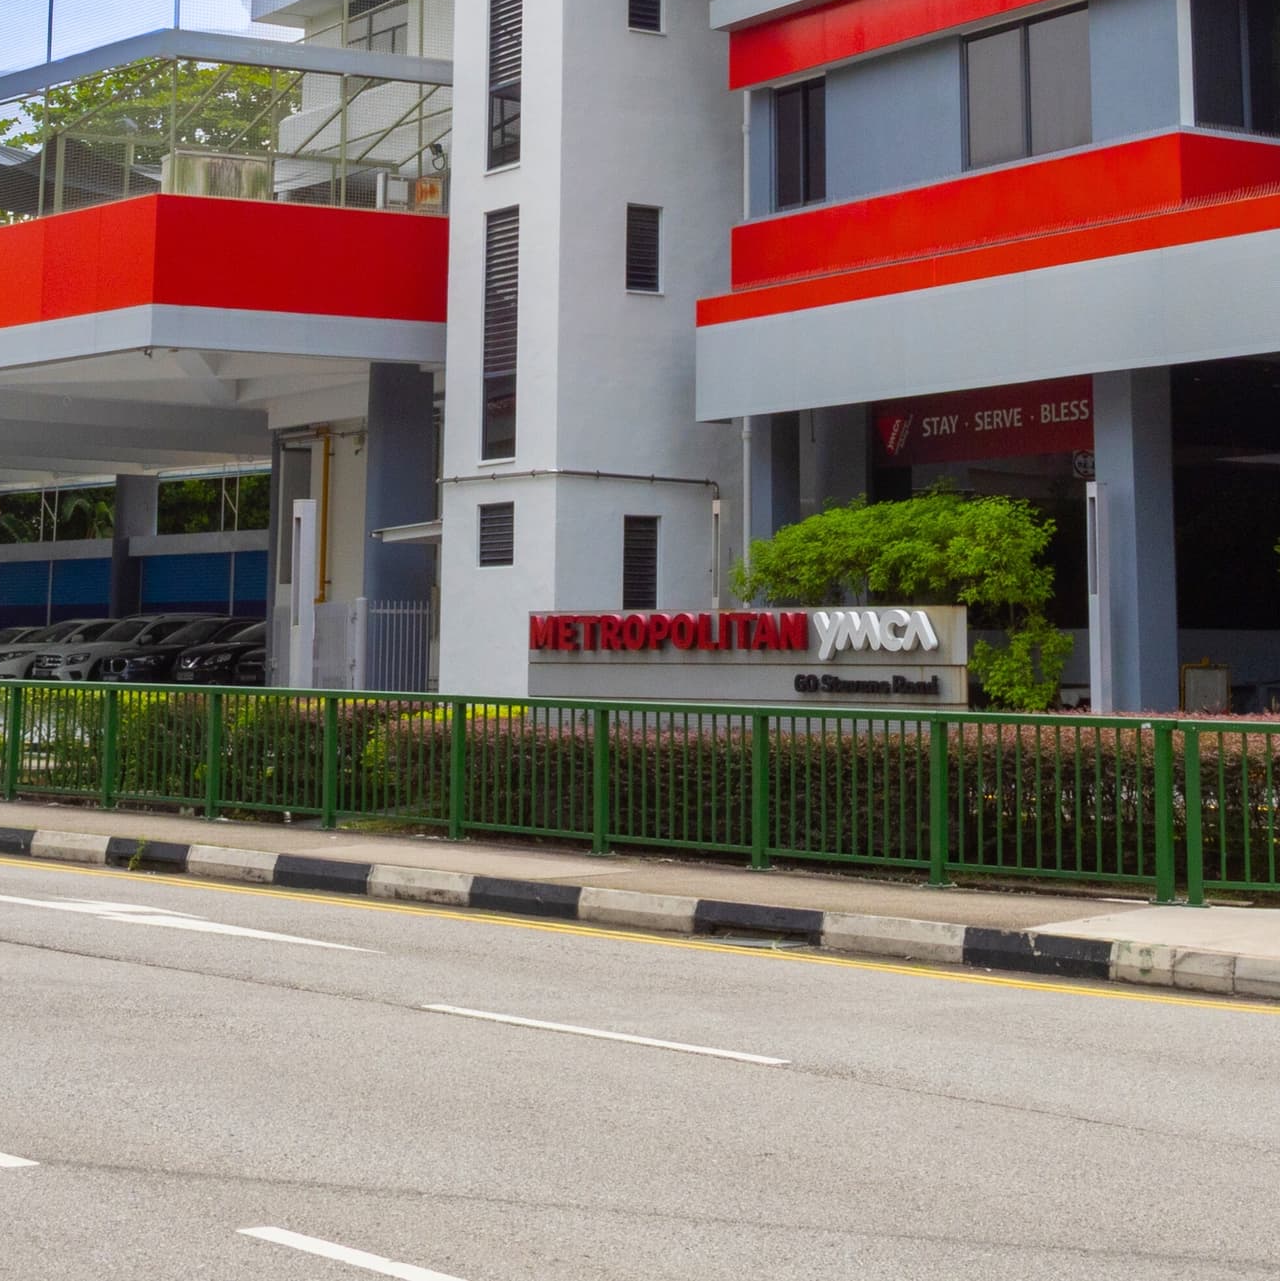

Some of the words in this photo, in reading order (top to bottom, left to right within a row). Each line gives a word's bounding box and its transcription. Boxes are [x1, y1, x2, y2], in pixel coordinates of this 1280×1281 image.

[922, 415, 959, 437] STAY
[974, 408, 1023, 432] SERVE
[1040, 399, 1090, 424] BLESS
[529, 612, 810, 652] METROPOLITAN
[813, 609, 938, 662] YMCA
